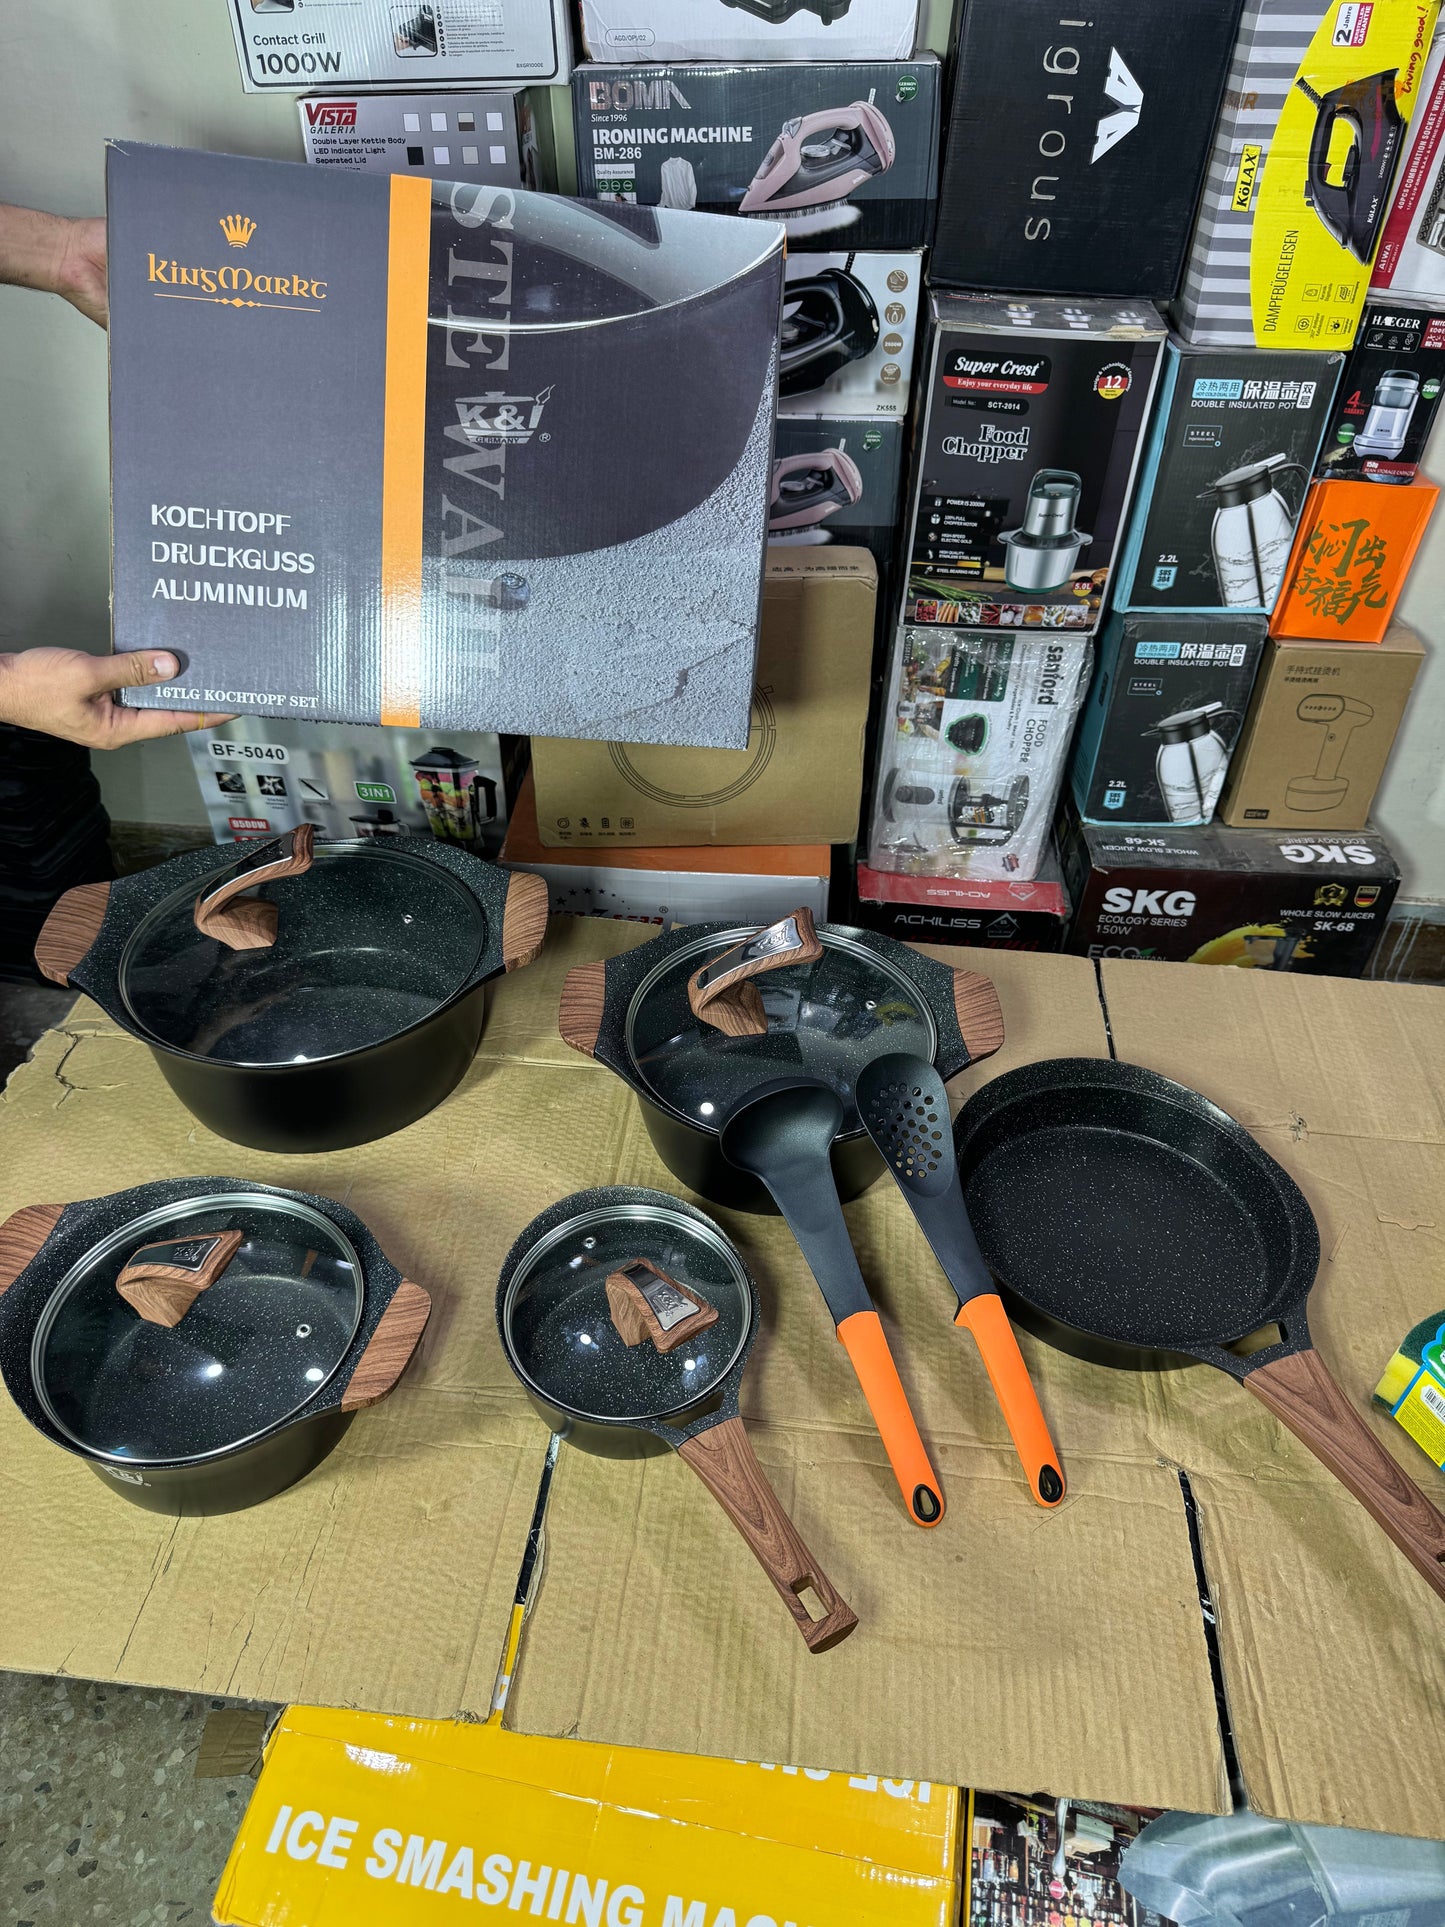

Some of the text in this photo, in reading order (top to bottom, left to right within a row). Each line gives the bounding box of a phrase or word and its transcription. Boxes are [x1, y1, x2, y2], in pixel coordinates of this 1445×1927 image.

[1357, 5, 1372, 44] GARANTIE
[253, 32, 326, 46] Contact Grill
[1336, 29, 1352, 43] 2
[1401, 5, 1429, 94] Living good!
[256, 51, 341, 75] 1000W
[305, 102, 358, 126] VISTA
[591, 113, 628, 123] Since 1996
[310, 126, 356, 134] GALERIA
[592, 126, 753, 145] IRONING MACHINE
[1024, 20, 1093, 241] igrous
[339, 138, 360, 146] Layer
[361, 137, 386, 145] Kettle
[387, 137, 406, 145] Body
[365, 147, 387, 155] Light
[594, 146, 642, 160] BM-286
[1404, 139, 1427, 189] COMBINATION
[1422, 113, 1436, 140] SOCKET
[315, 157, 353, 165] Seperated
[1379, 243, 1393, 271] AIWA
[1263, 229, 1299, 332] DAMPFBÜGELEISEN
[954, 357, 1040, 377] Super Crest
[957, 378, 1033, 391] Enjoy your everyday life
[1104, 375, 1123, 389] 12
[1243, 380, 1301, 400] 保温壶
[876, 404, 897, 412] ZK555
[988, 401, 1020, 411] SCT-2014
[1191, 400, 1226, 409] DOUBLE
[1228, 401, 1275, 409] INSULATED
[1347, 391, 1361, 409] 4
[477, 436, 520, 445] GERMANY
[979, 424, 1031, 446] Food
[942, 436, 1029, 464] Chopper
[151, 503, 292, 535] KOCHTOPF
[151, 541, 316, 574] DRUCKGUSS
[1158, 554, 1179, 563] 2.2L
[151, 578, 308, 610] ALUMINIUM
[1181, 643, 1233, 660] 保温壶
[1134, 658, 1165, 666] DOUBLE
[1168, 659, 1211, 667] INSULATED
[1037, 645, 1065, 706] sanford
[155, 685, 319, 709] 16TLG KOCHTOPF SET
[1018, 718, 1036, 764] CHOPPER
[1034, 719, 1048, 748] FOOD
[212, 742, 285, 761] BF-5040
[360, 786, 392, 799] 3IN1
[1108, 780, 1127, 788] 2.2L
[1101, 844, 1200, 856] WHOLE SLOW JUICER
[1125, 836, 1166, 847] SK-68
[1279, 844, 1377, 866] SKG
[1101, 887, 1197, 917] SKG
[1098, 914, 1188, 928] ECOLOGY SERIES
[1280, 909, 1376, 920] WHOLE SLOW JUICER
[1095, 923, 1133, 936] 150W
[1312, 920, 1356, 933] SK-68
[264, 1803, 360, 1870] ICE
[363, 1827, 646, 1927] SMASHING
